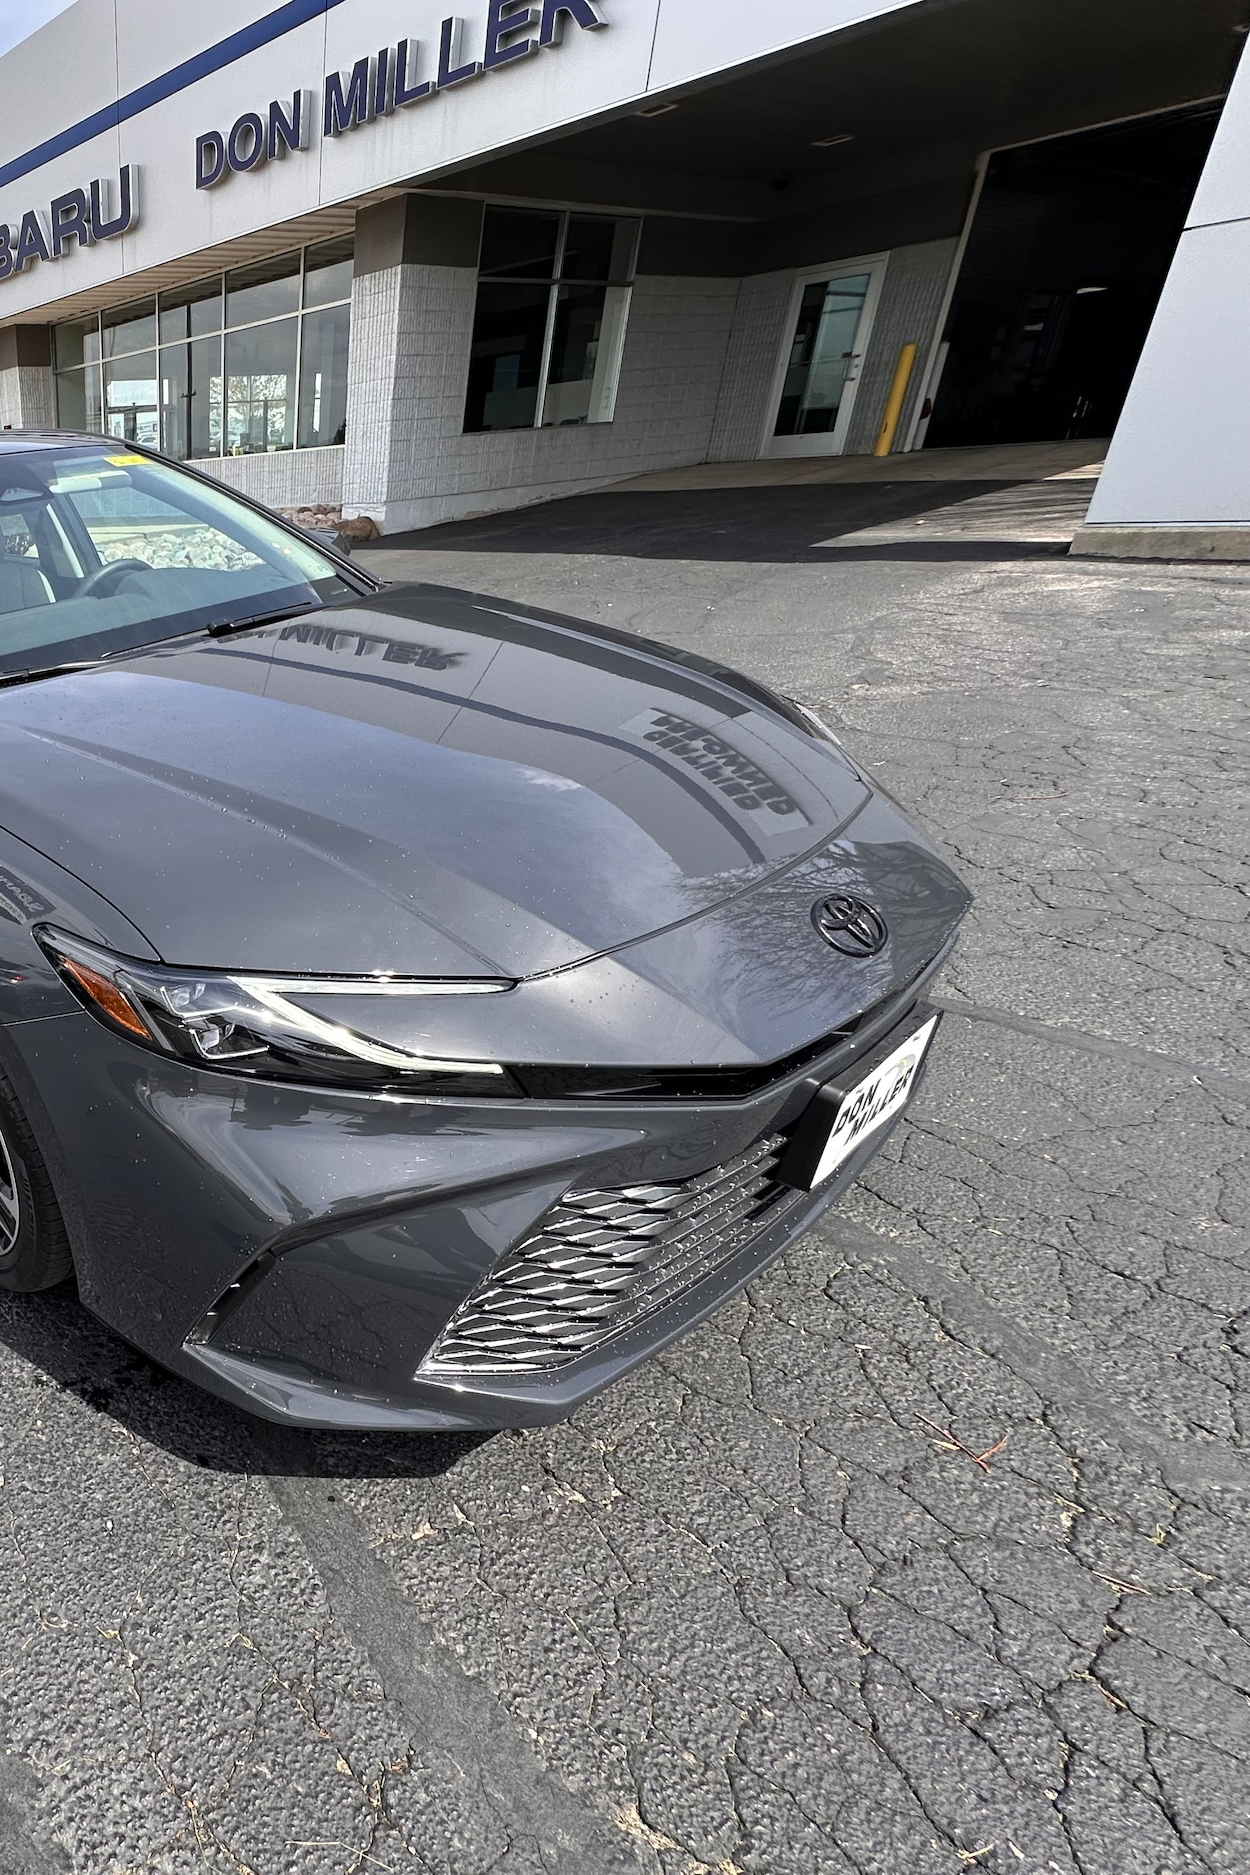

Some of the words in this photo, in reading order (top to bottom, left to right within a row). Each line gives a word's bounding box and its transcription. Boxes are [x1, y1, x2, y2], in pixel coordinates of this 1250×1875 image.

[195, 88, 311, 190] DON
[832, 1078, 882, 1138] DON
[844, 1064, 914, 1146] MILLER
